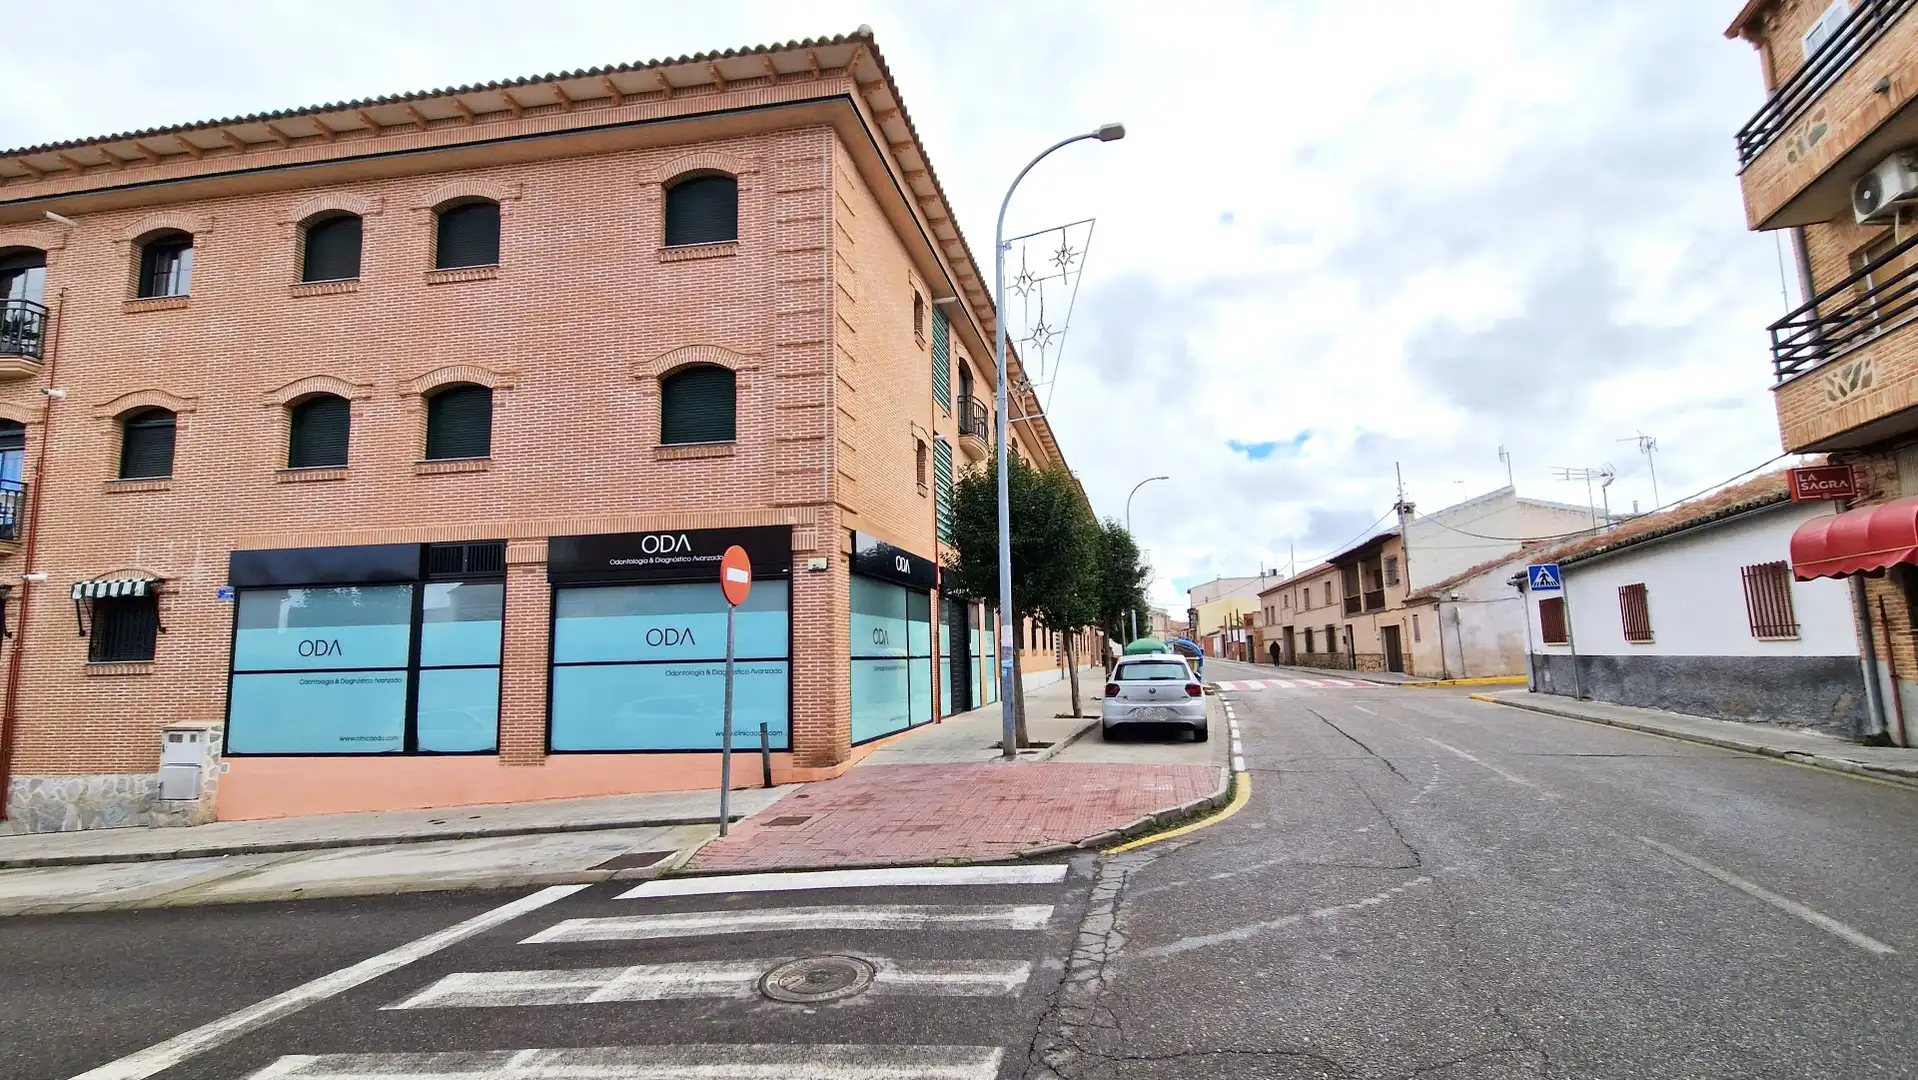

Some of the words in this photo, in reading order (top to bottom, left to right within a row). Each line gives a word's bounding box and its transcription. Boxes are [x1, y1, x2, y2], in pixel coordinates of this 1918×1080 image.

[1799, 472, 1818, 482] LA
[1800, 480, 1849, 491] SAGRA
[641, 534, 692, 554] ODA
[895, 555, 910, 574] ODA
[646, 627, 696, 647] ODA
[872, 628, 889, 644] ODA
[298, 639, 342, 657] ODA
